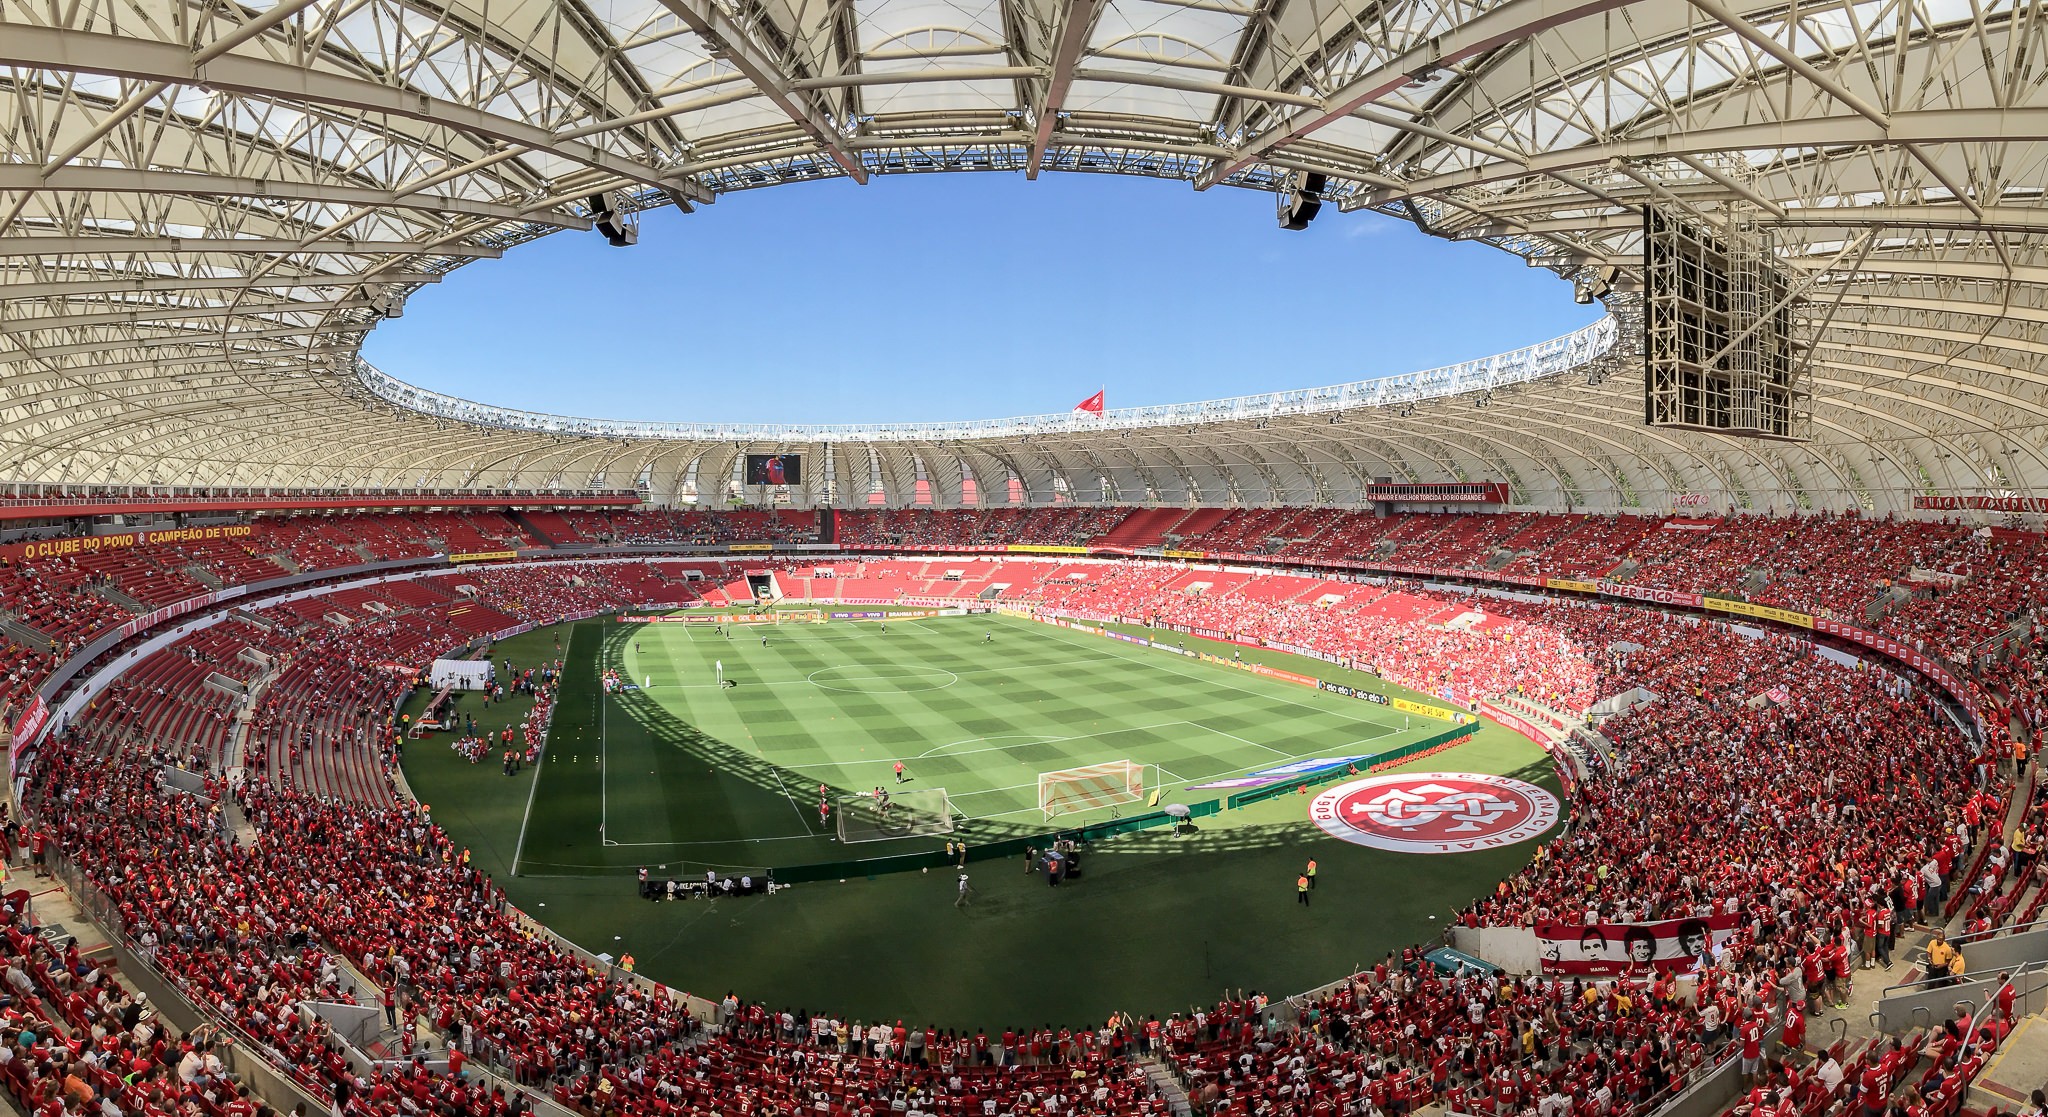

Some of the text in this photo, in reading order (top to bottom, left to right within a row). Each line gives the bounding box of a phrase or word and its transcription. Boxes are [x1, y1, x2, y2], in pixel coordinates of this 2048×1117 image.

[26, 526, 250, 558] O CLUBE DO POVO CAMPEÃO DE TUDO
[1597, 582, 1638, 598] SUPER
[1643, 589, 1673, 602] FICO
[1326, 683, 1379, 702] elo elo elo elo
[1316, 795, 1335, 820] 1909
[1435, 776, 1553, 851] INTERNACIONAL
[1786, 1014, 1796, 1028] 10
[1750, 1028, 1758, 1041] 10
[1879, 1084, 1886, 1100] 9
[135, 1096, 144, 1110] 10
